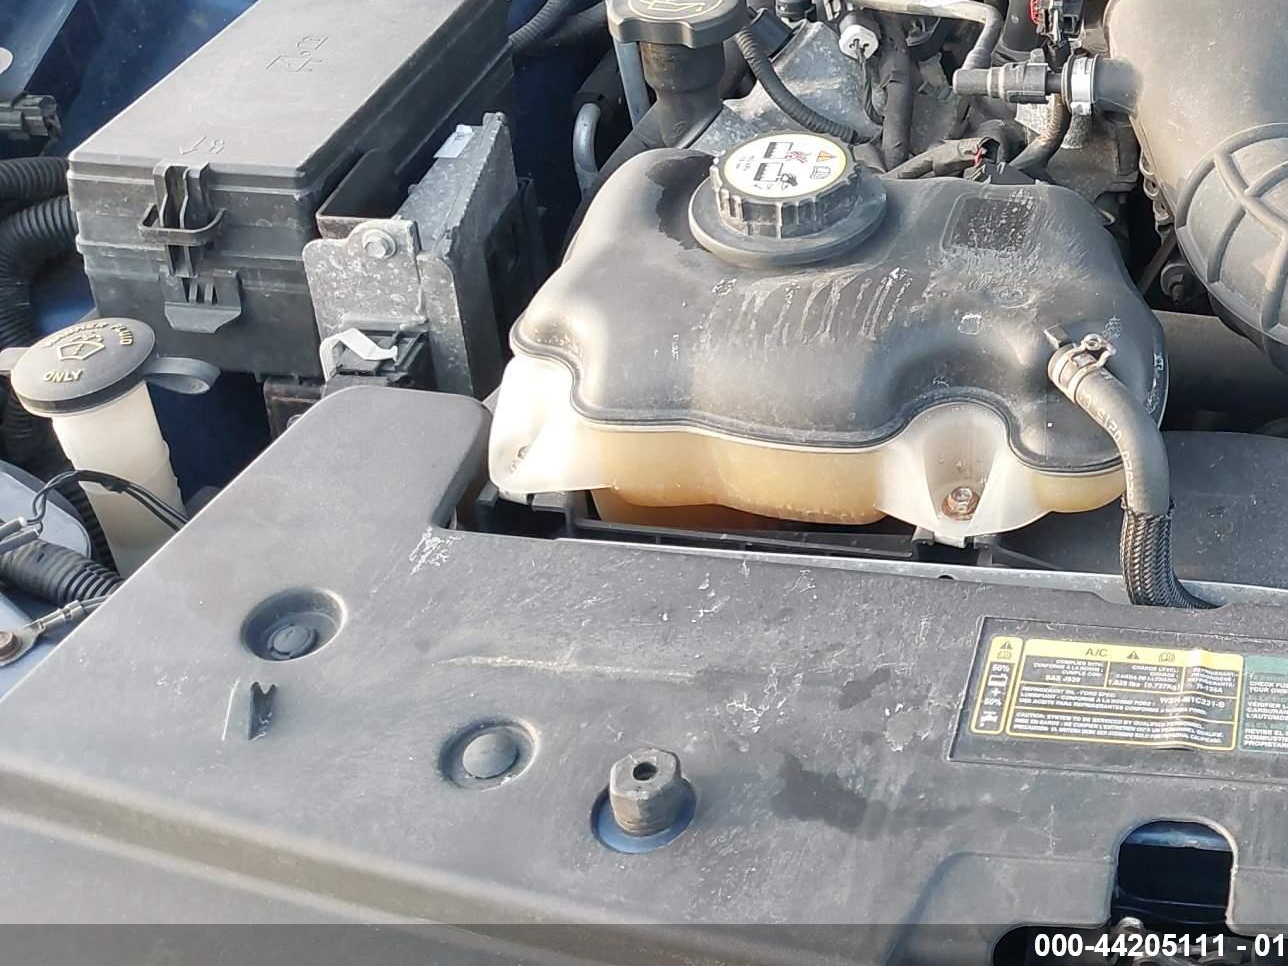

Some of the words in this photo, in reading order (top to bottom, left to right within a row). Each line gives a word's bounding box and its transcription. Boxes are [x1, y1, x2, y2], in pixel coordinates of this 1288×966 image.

[111, 323, 133, 346] FLUID
[42, 369, 82, 382] ONLY
[1085, 647, 1108, 657] A/C
